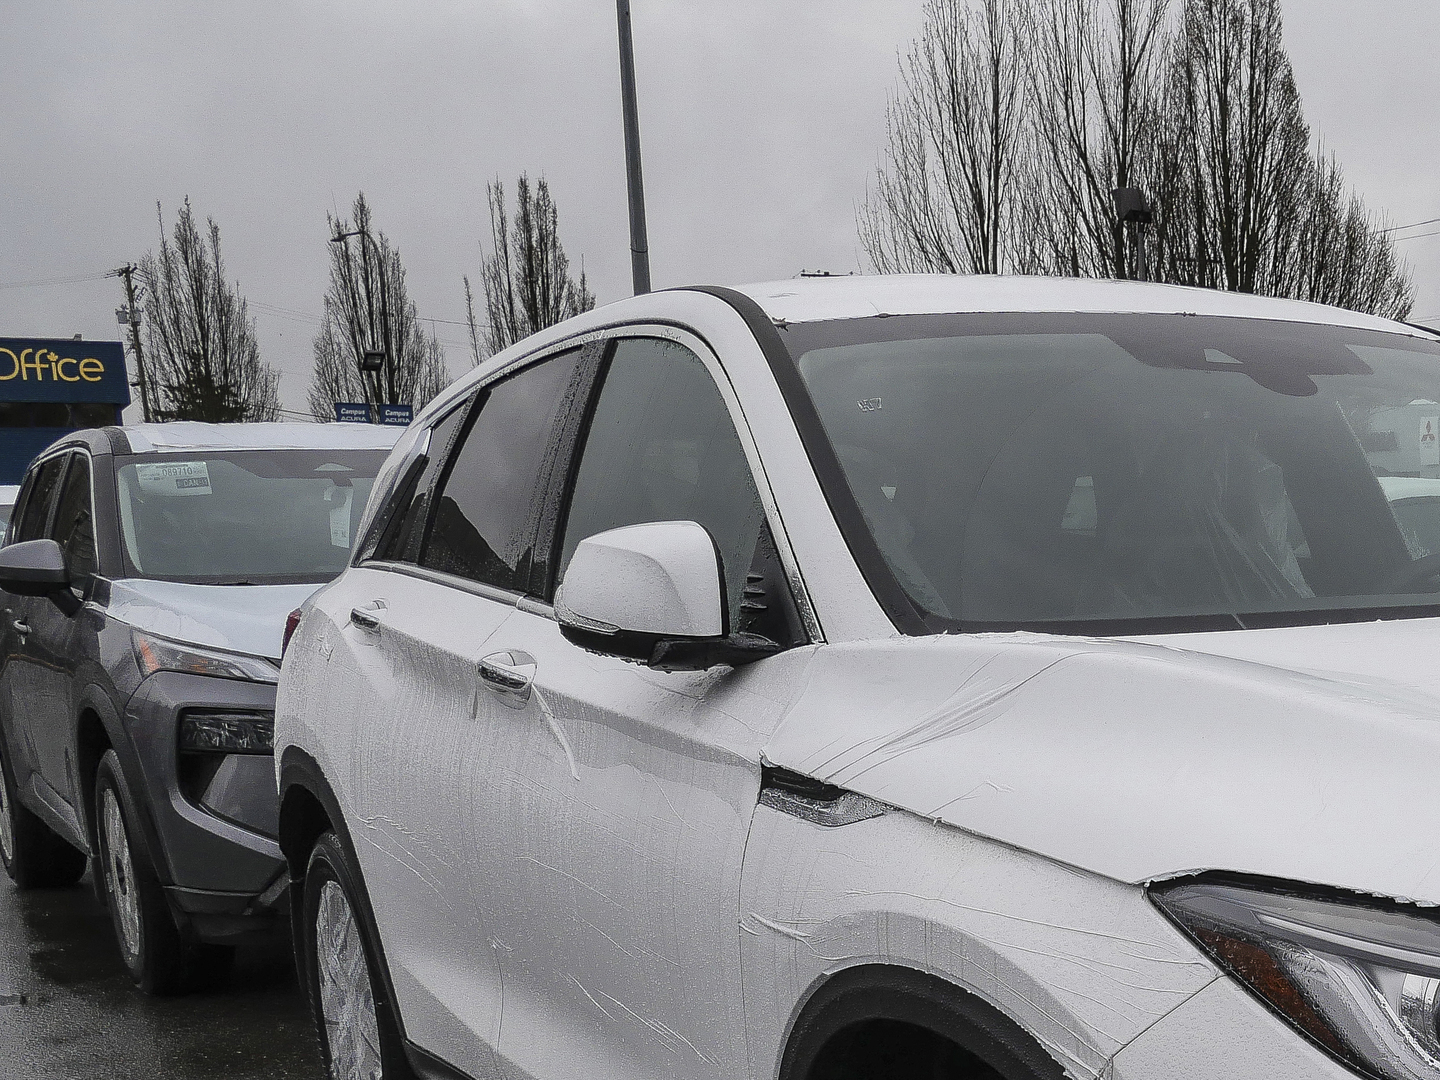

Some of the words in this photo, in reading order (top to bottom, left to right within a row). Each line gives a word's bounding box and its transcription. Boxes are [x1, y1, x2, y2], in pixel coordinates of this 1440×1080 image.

[0, 347, 105, 381] Office
[340, 407, 366, 416] Campus
[385, 409, 410, 417] Campus
